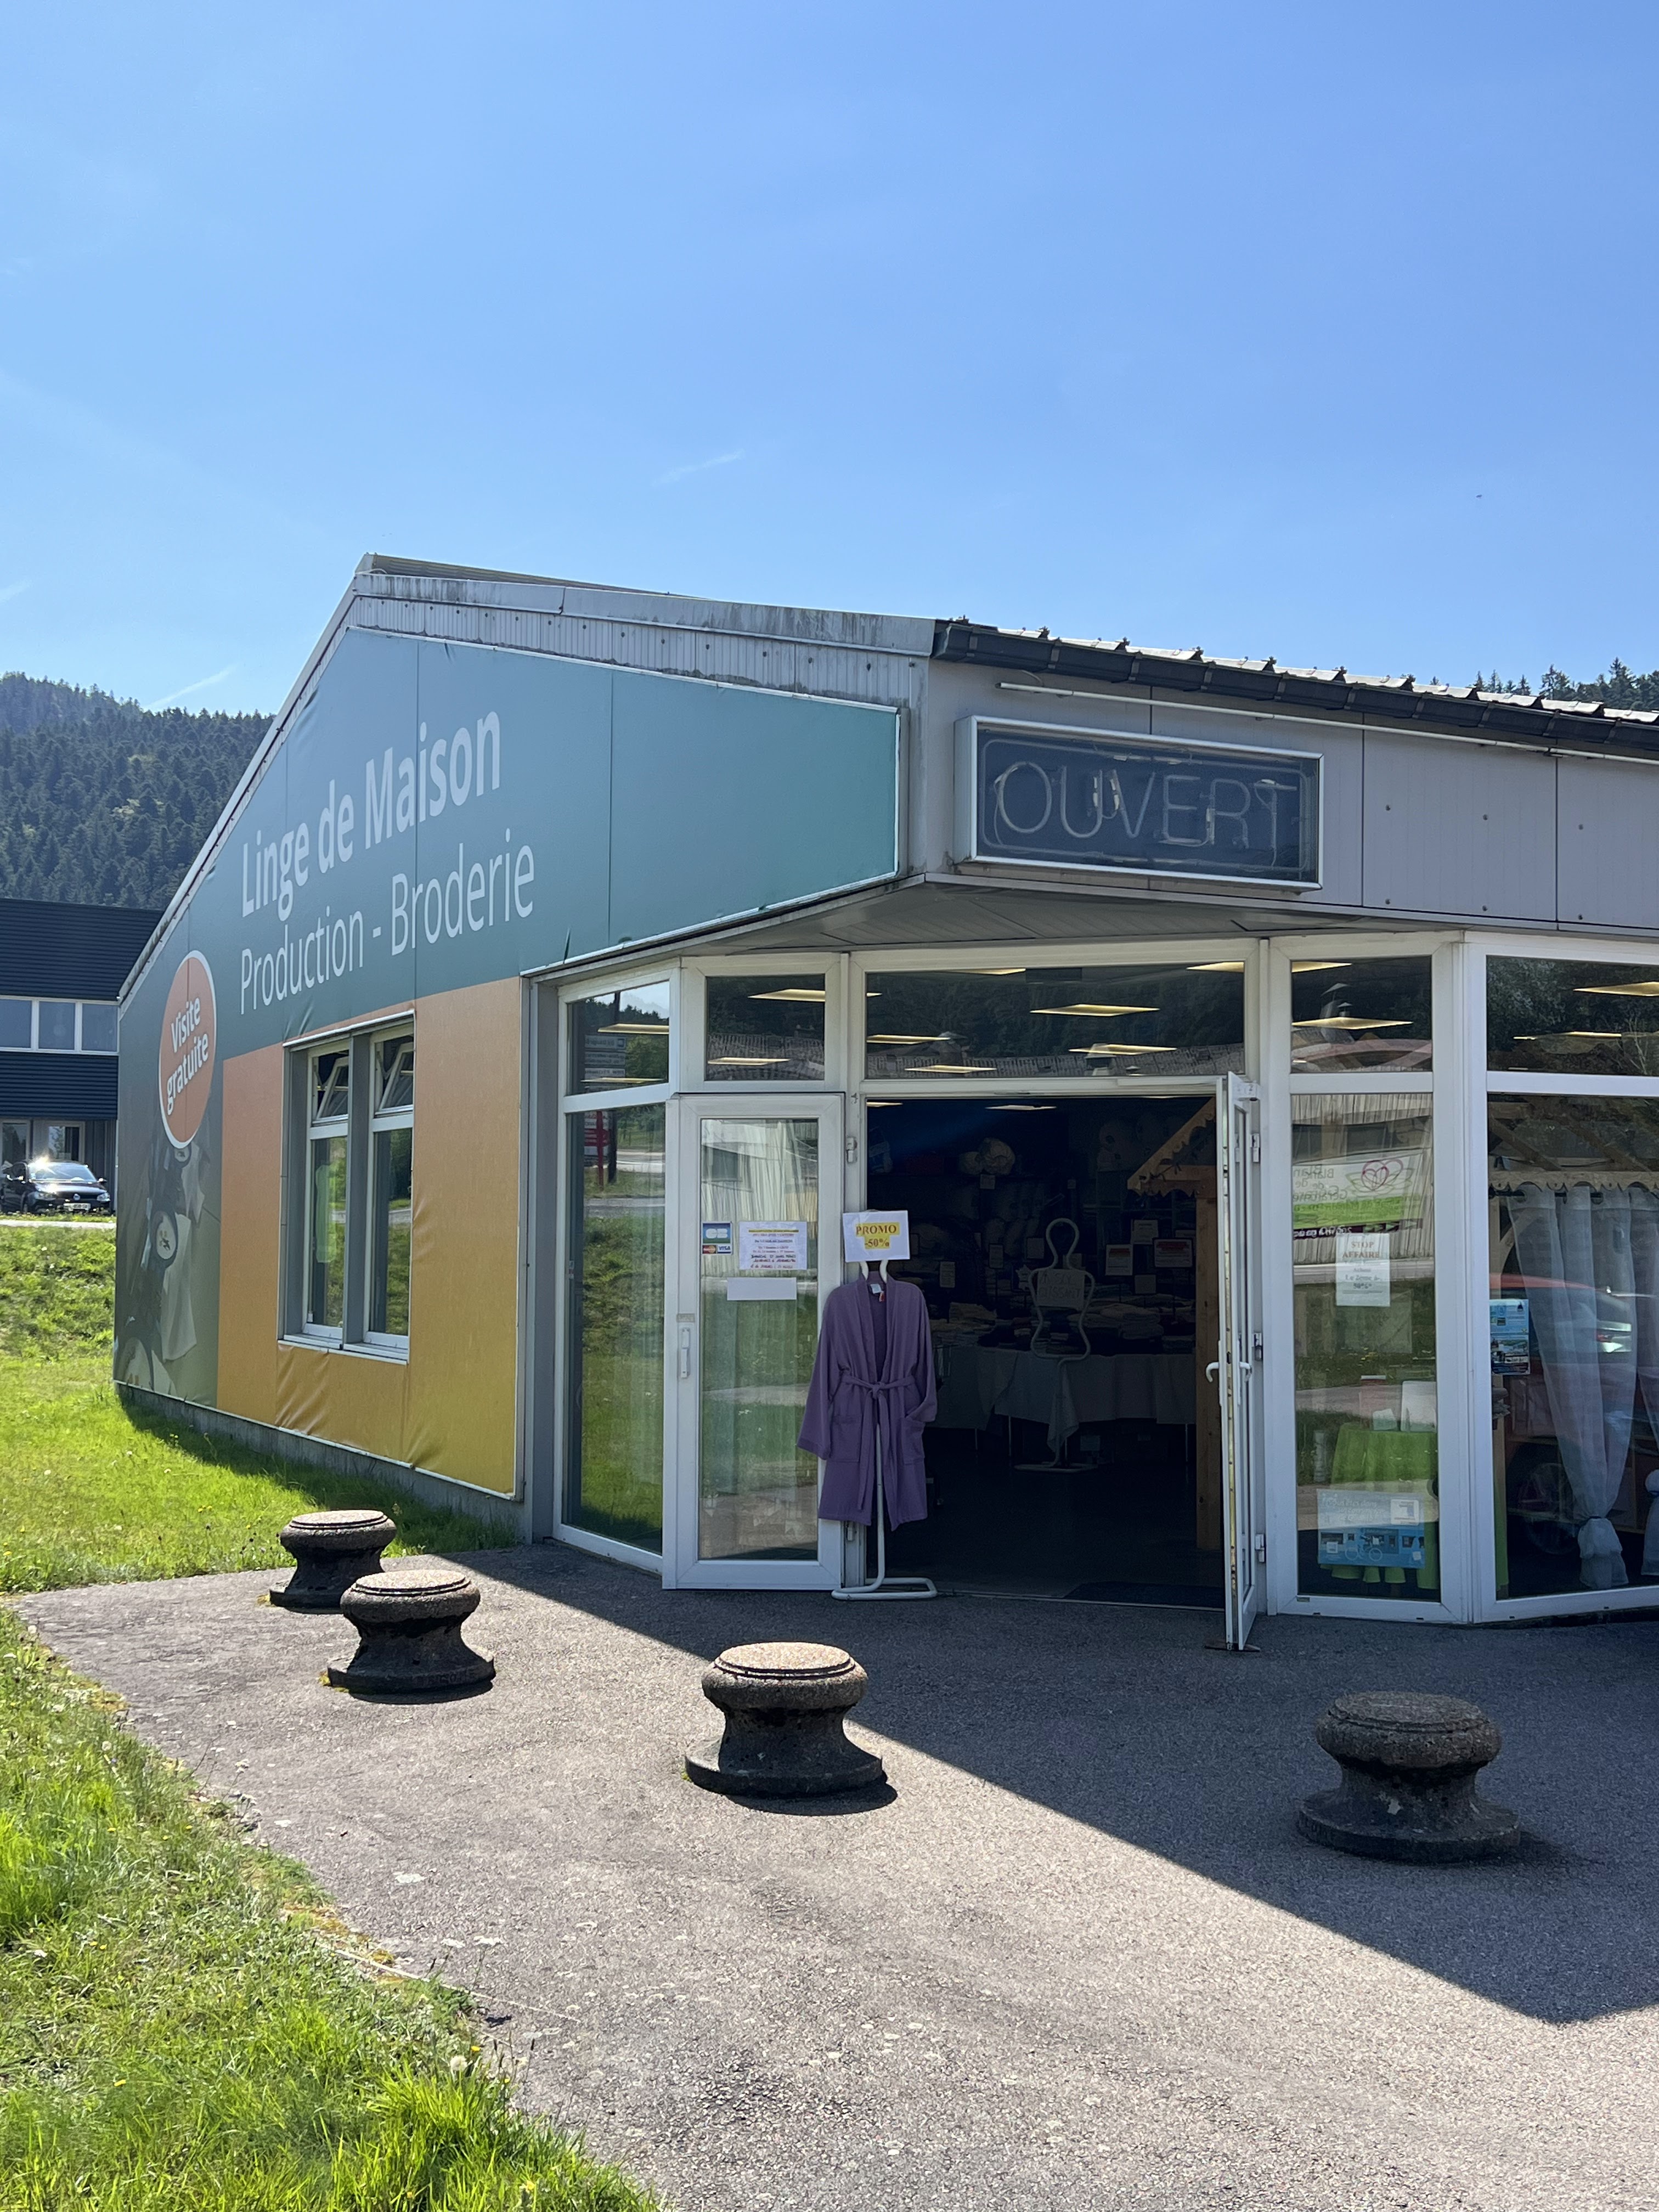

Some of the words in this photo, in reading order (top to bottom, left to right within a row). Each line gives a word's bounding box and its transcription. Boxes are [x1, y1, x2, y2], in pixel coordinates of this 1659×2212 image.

[241, 822, 310, 922] Linge
[318, 778, 354, 874] de
[365, 710, 501, 850] Maison
[997, 760, 1298, 855] OUVERT
[239, 906, 364, 1015] Production
[391, 828, 535, 957] Broderie
[170, 995, 201, 1053] Visite
[166, 1032, 210, 1117] gratuite
[856, 1224, 897, 1235] PROMO
[865, 1238, 890, 1248] -50%
